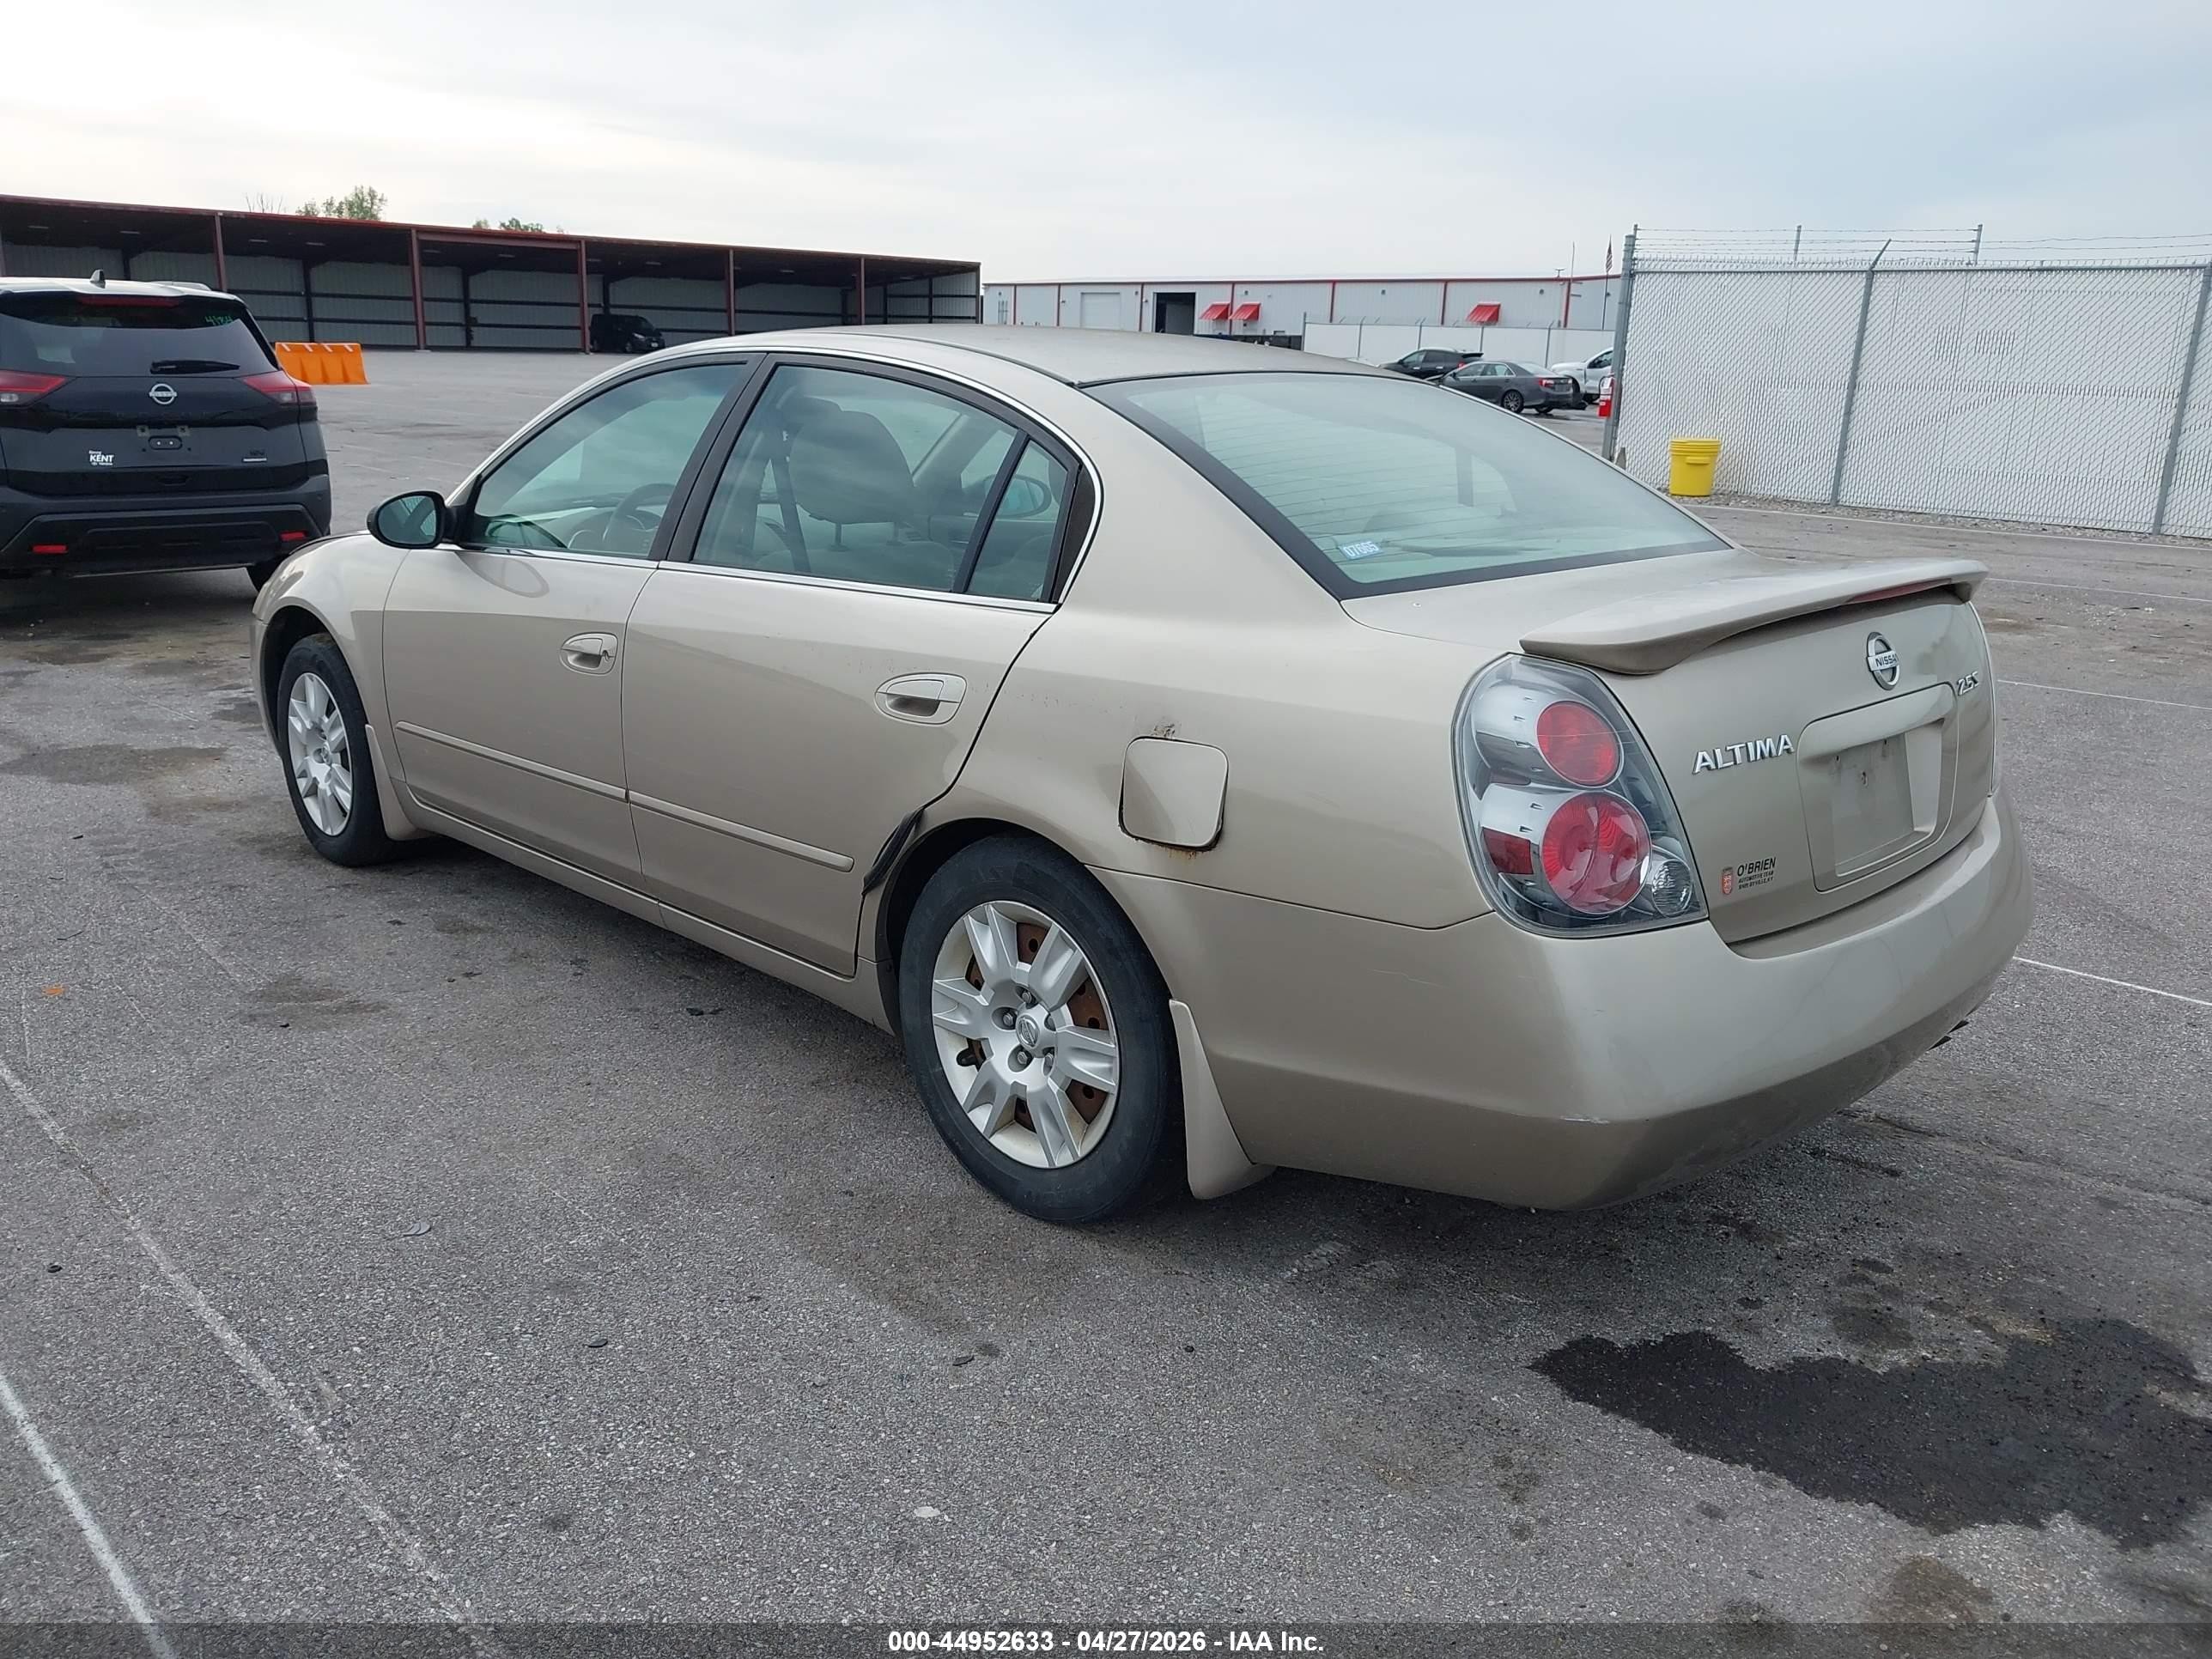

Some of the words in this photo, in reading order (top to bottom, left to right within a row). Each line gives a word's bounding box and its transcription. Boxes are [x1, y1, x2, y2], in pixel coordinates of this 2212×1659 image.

[89, 453, 114, 463] KENT
[1692, 733, 1796, 775] ALTIMA
[1737, 857, 1777, 877] O'BRIEN
